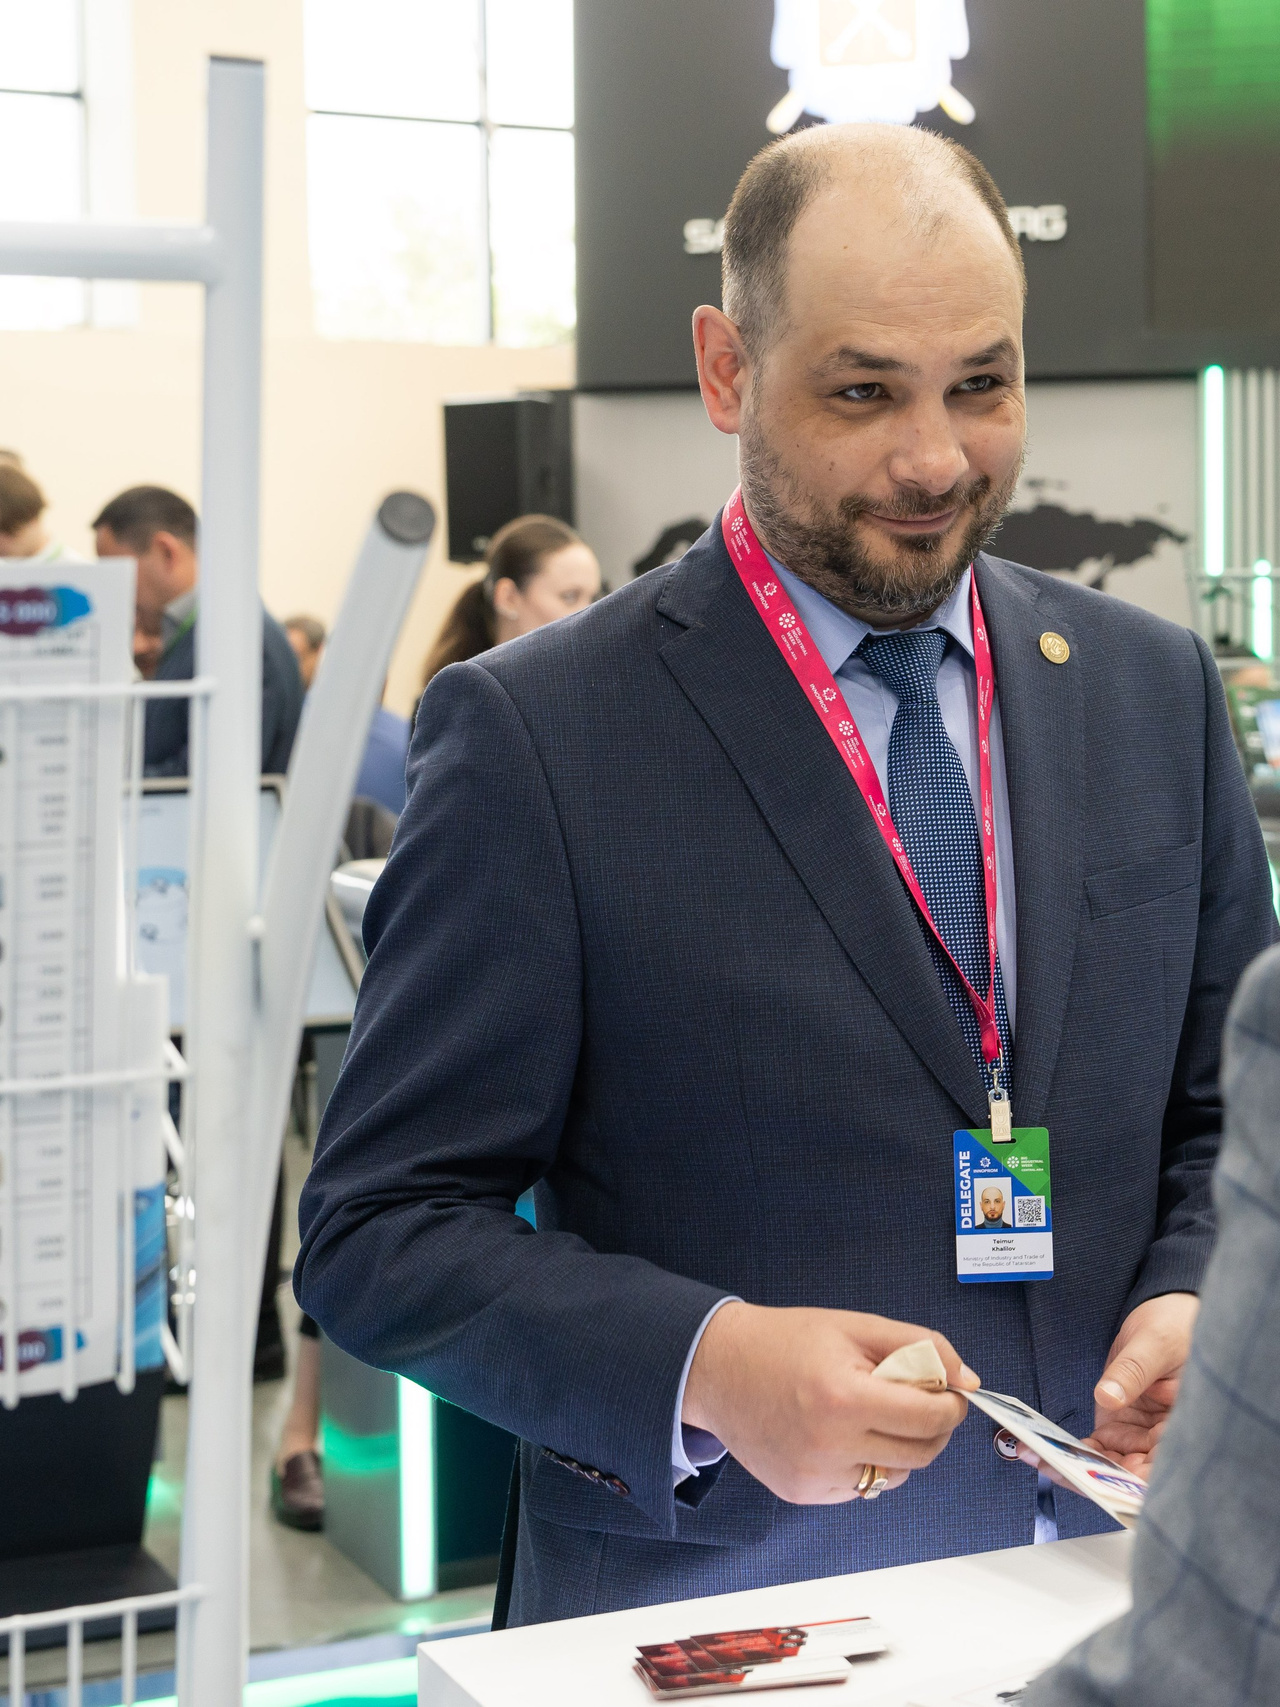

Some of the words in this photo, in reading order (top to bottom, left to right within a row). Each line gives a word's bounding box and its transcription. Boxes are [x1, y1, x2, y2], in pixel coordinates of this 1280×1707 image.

[752, 581, 770, 610] INNOPROM
[787, 631, 796, 646] WEEK
[791, 629, 808, 656] INDUSTRIAL
[810, 683, 829, 714] INNOPROM
[959, 1151, 973, 1229] DELEGATE
